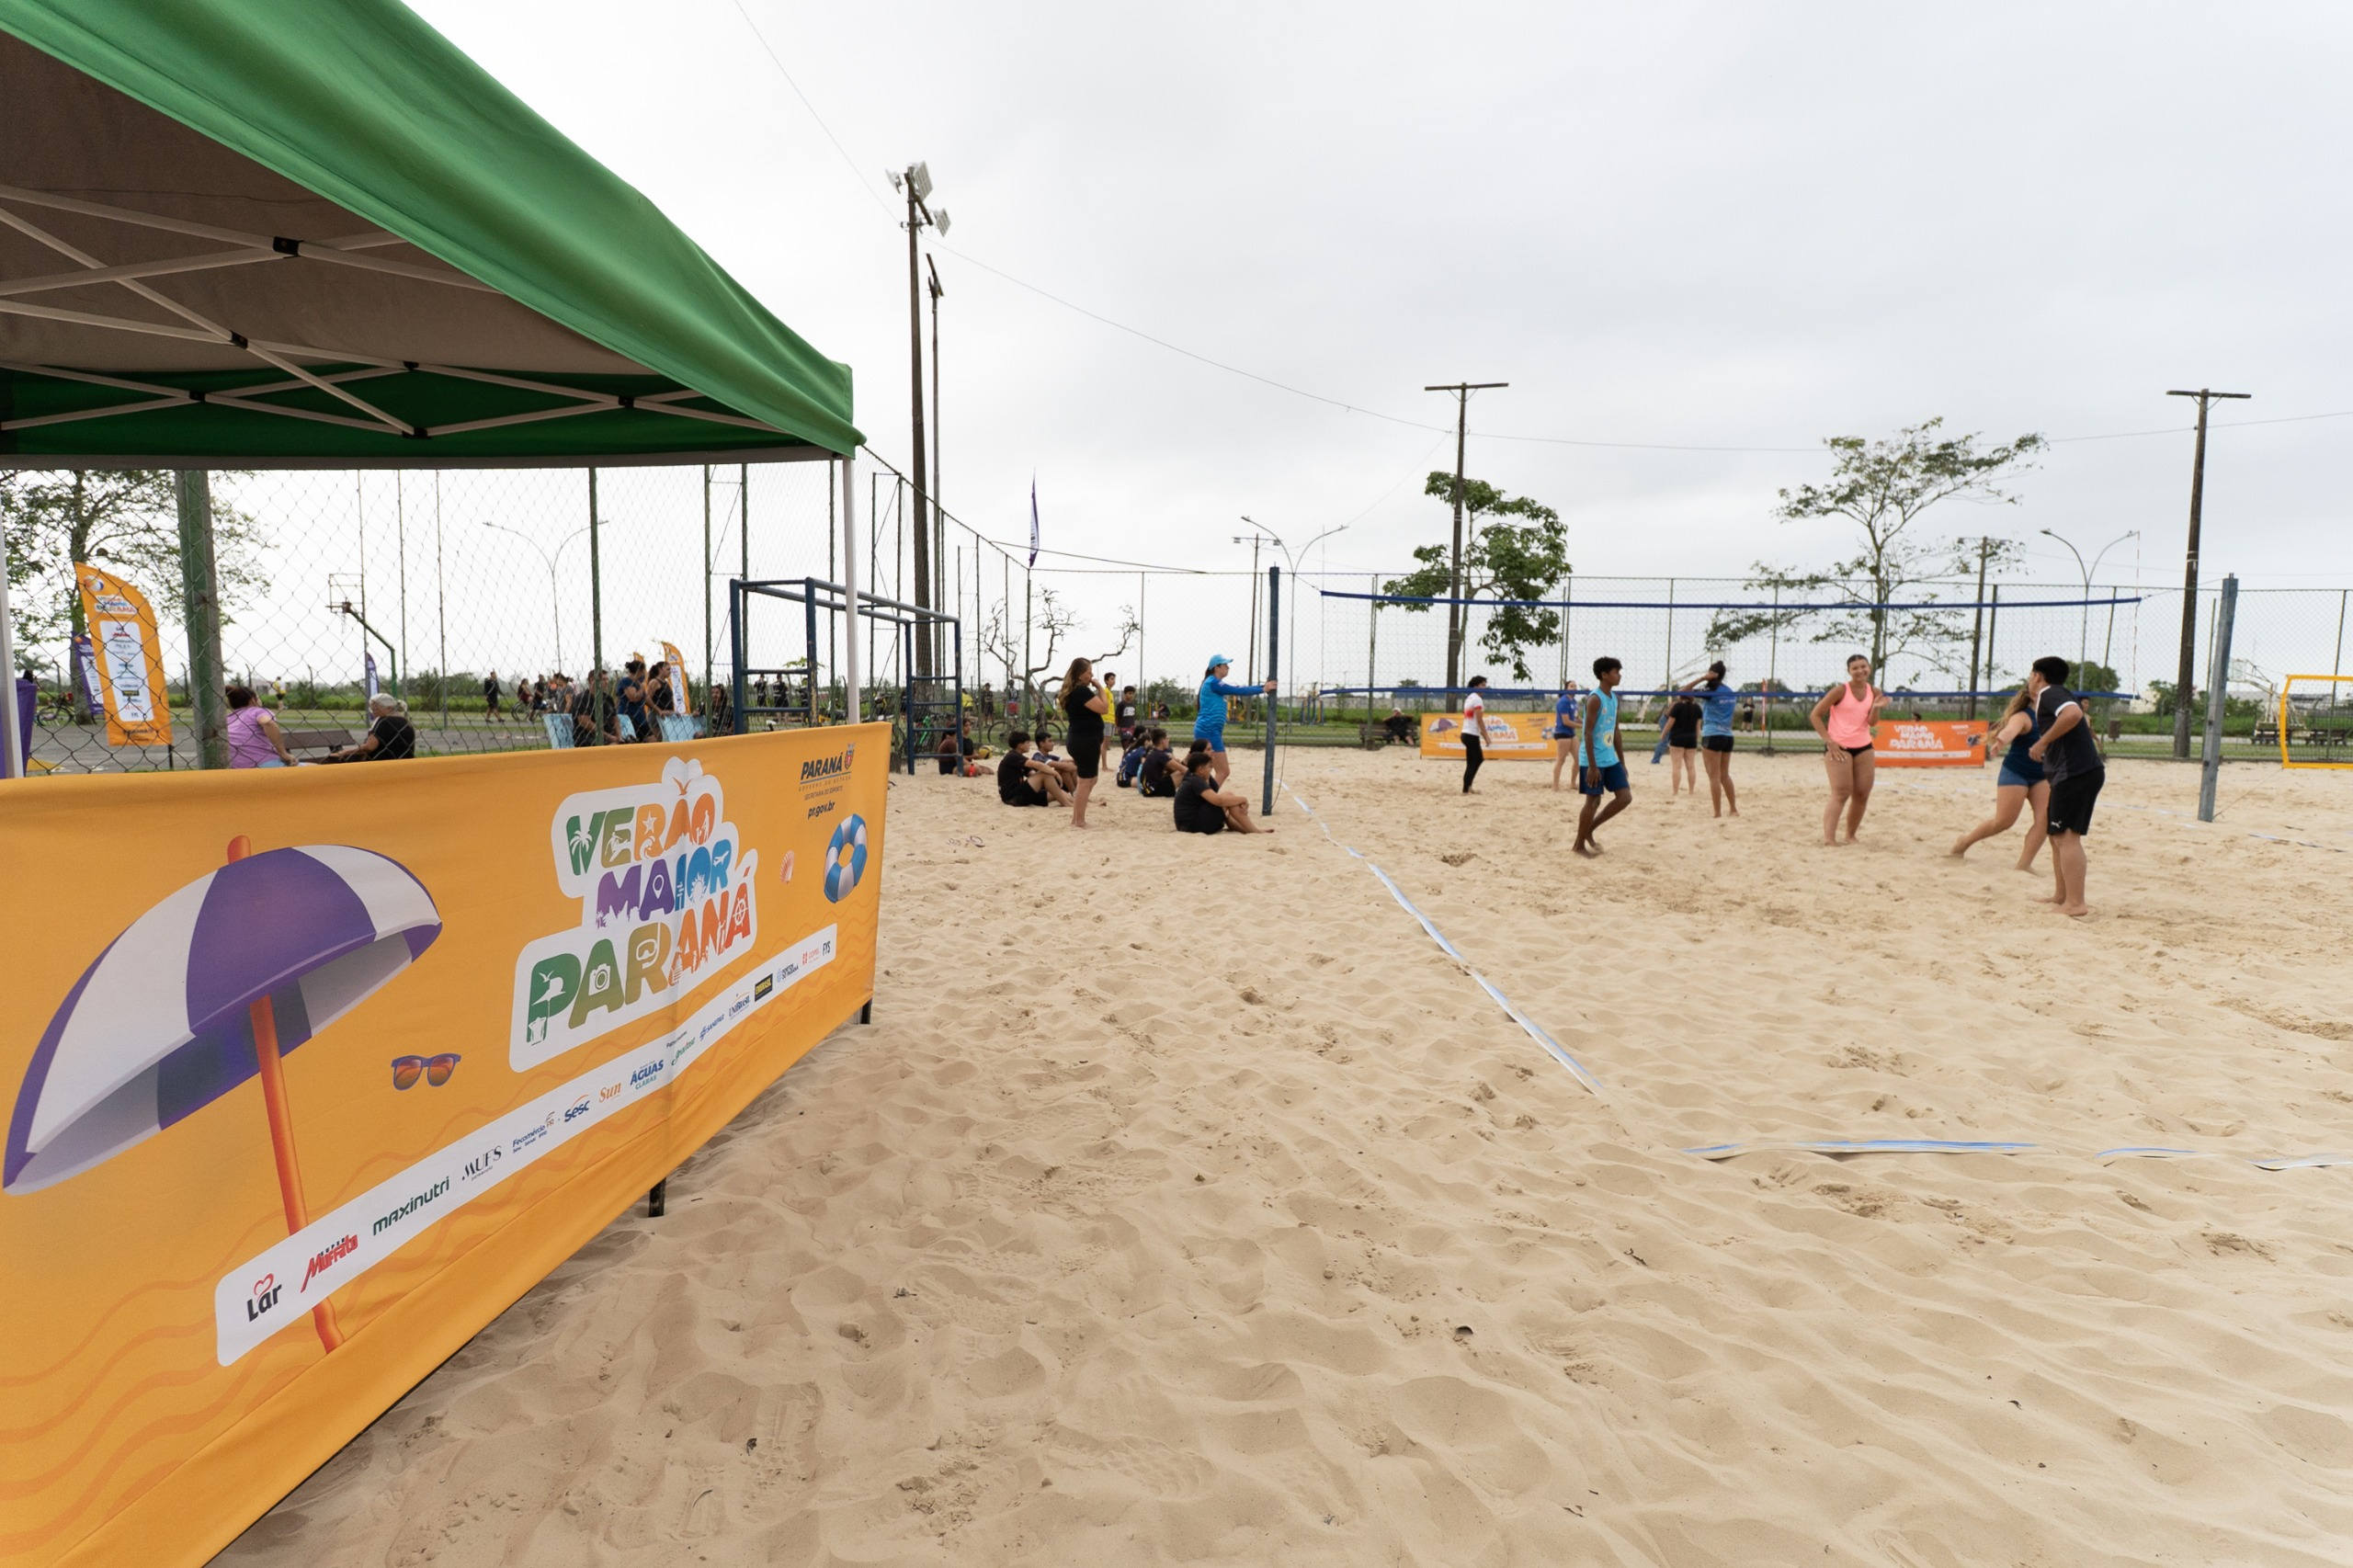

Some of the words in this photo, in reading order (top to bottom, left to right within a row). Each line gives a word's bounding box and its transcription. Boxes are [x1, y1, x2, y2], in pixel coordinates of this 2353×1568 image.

[801, 752, 843, 780] PARANÁ
[808, 800, 835, 820] pr.gov.br
[565, 778, 716, 876] VERÃO
[595, 838, 733, 929] MAIOR
[526, 866, 752, 1045] PARANÁ
[823, 940, 831, 956] FYS
[630, 1060, 664, 1085] ÁGUAS
[635, 1074, 657, 1090] CLARAS
[599, 1082, 622, 1103] Sun
[512, 1124, 546, 1148] Fecomércio
[373, 1176, 450, 1236] maxinutri
[246, 1284, 282, 1323] Lar
